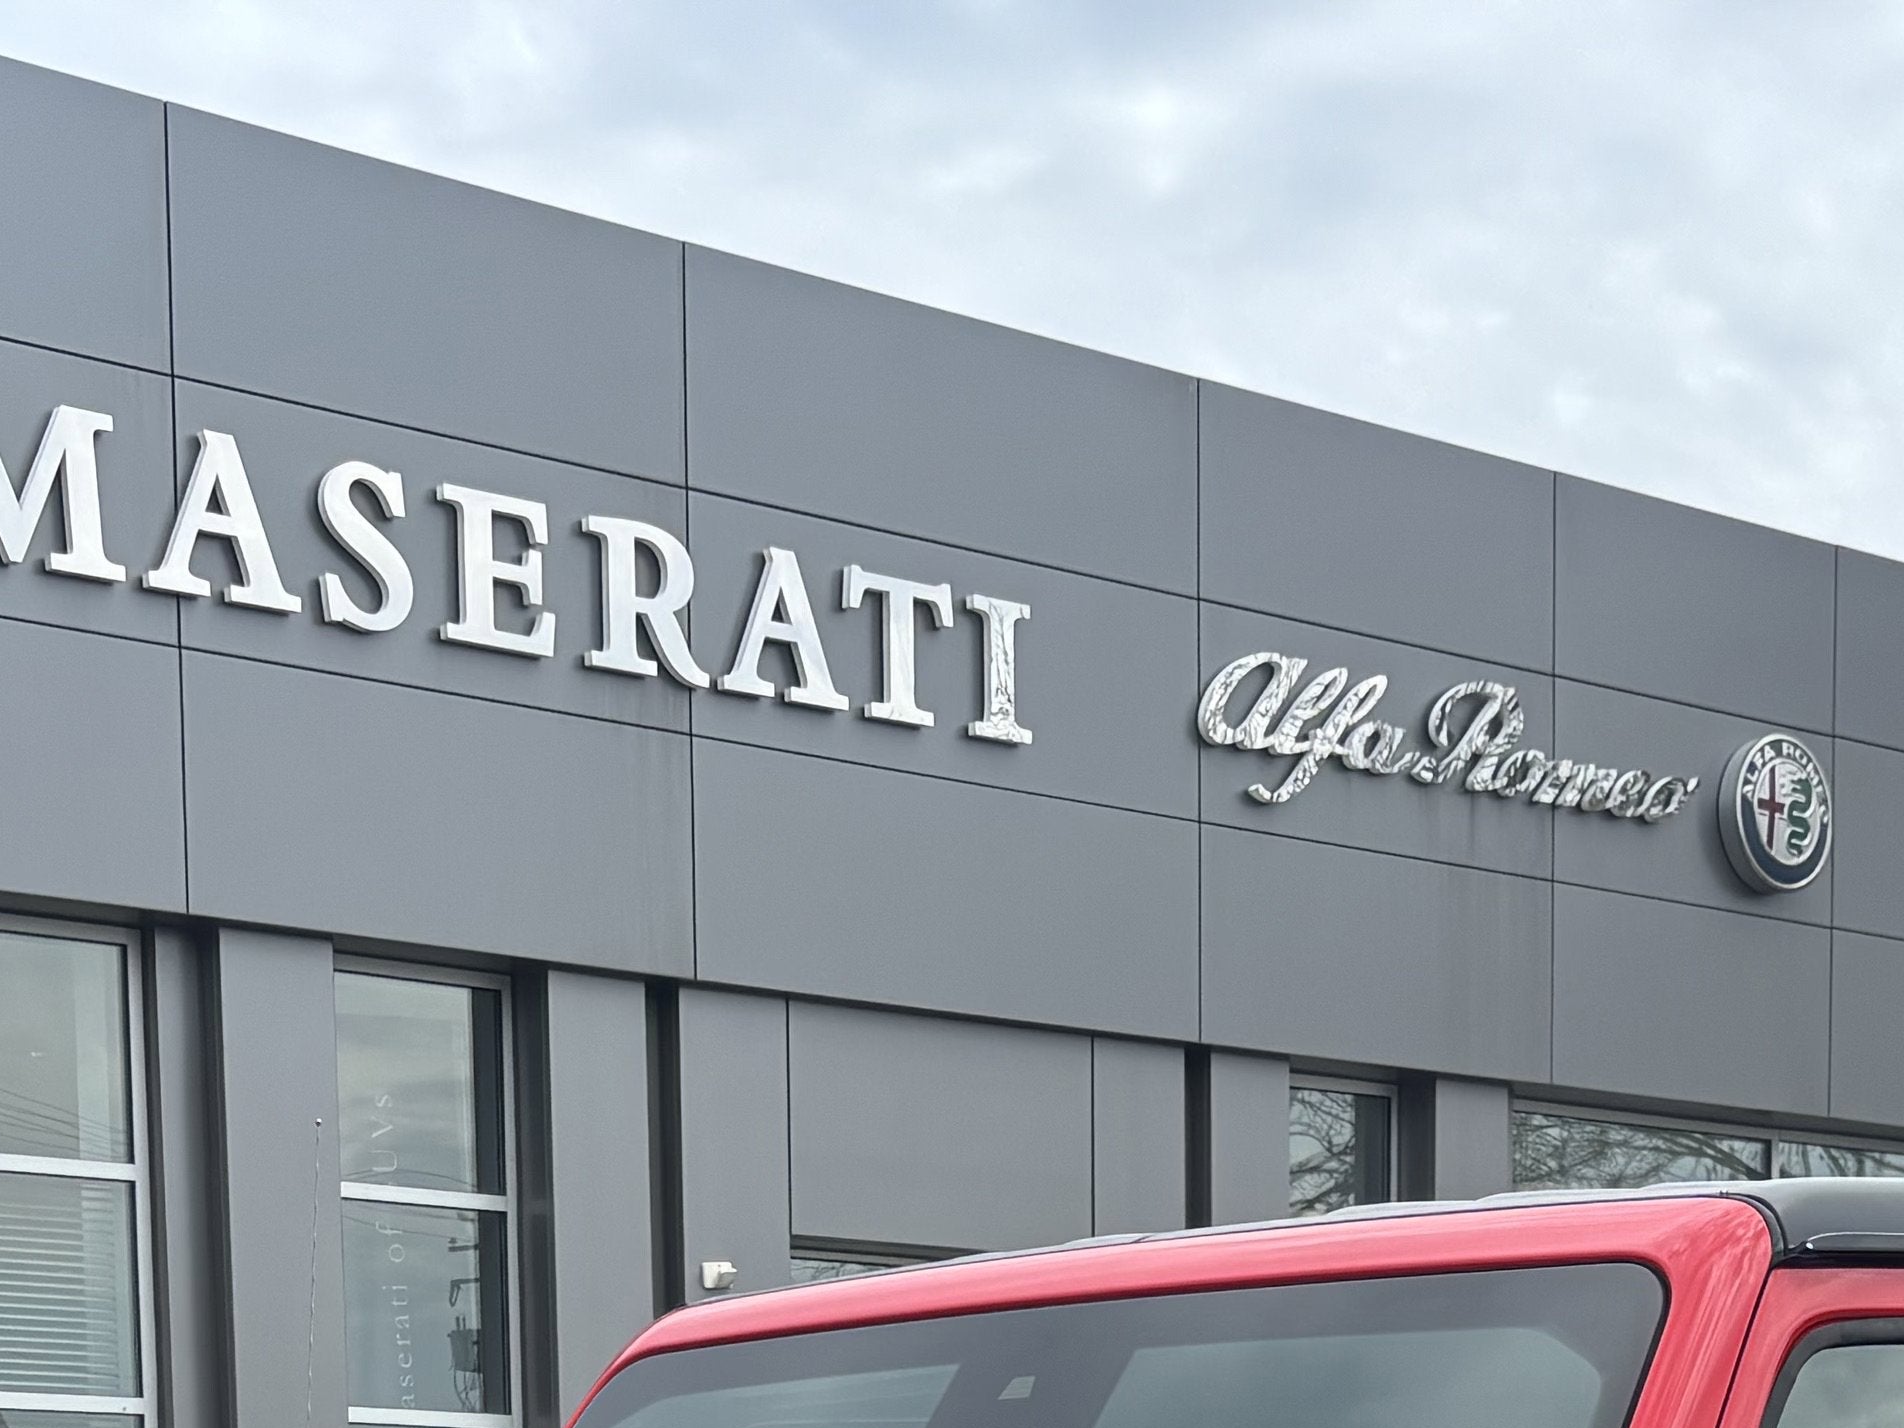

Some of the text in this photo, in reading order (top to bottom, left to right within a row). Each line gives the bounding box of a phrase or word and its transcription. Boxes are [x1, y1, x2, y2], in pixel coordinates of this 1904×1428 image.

[1197, 651, 1698, 823] Alfa Romeo
[1742, 744, 1777, 802] ALFA
[371, 1092, 398, 1187] UVs
[375, 1219, 407, 1264] of
